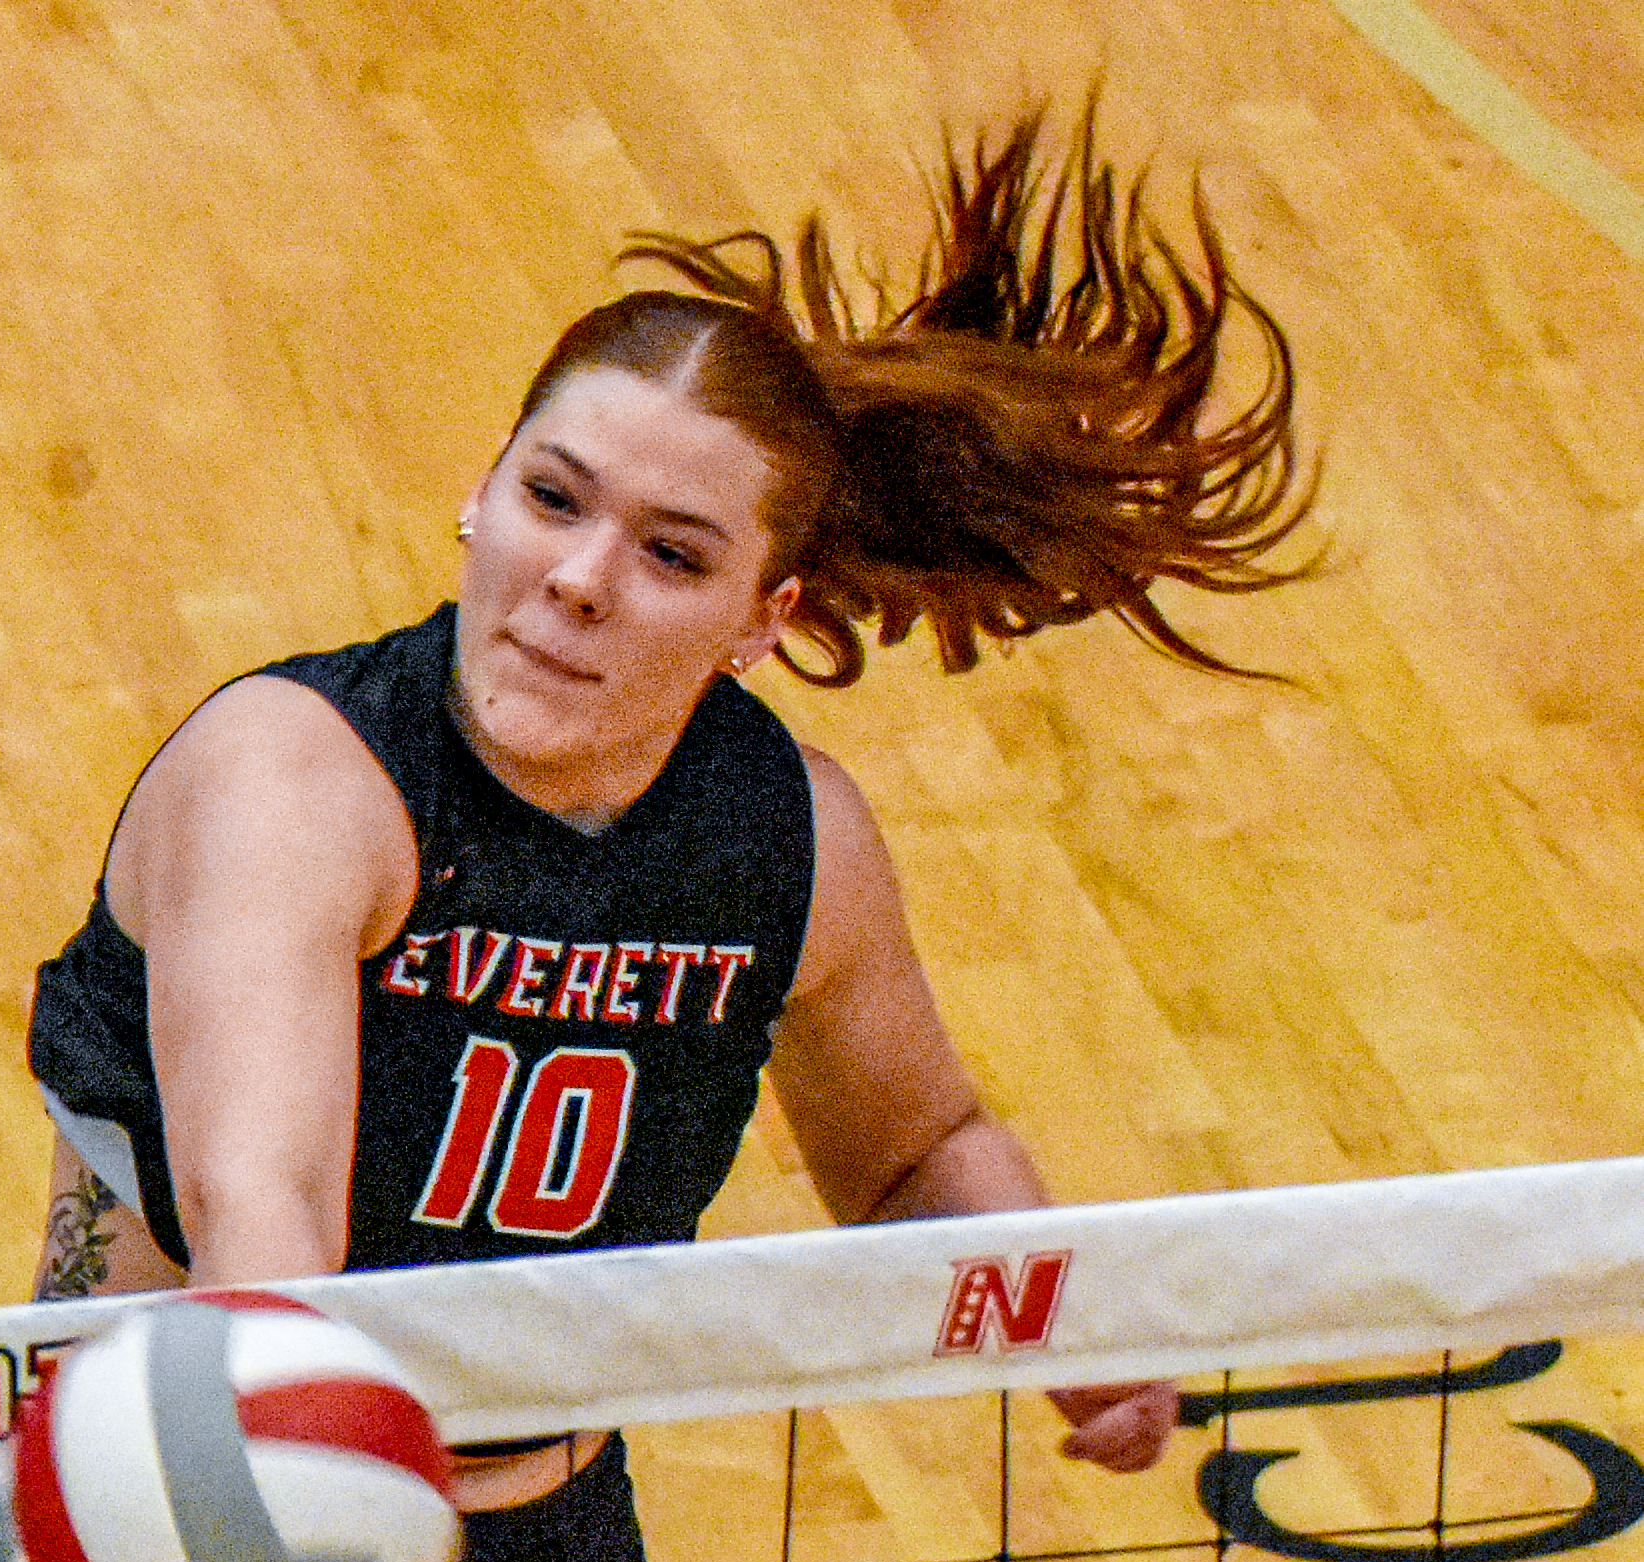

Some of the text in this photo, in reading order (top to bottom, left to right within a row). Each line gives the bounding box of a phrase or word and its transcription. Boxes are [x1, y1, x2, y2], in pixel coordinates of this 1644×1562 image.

[379, 926, 755, 1026] EVERETT
[411, 1036, 636, 1239] 10
[933, 1249, 1073, 1357] N
